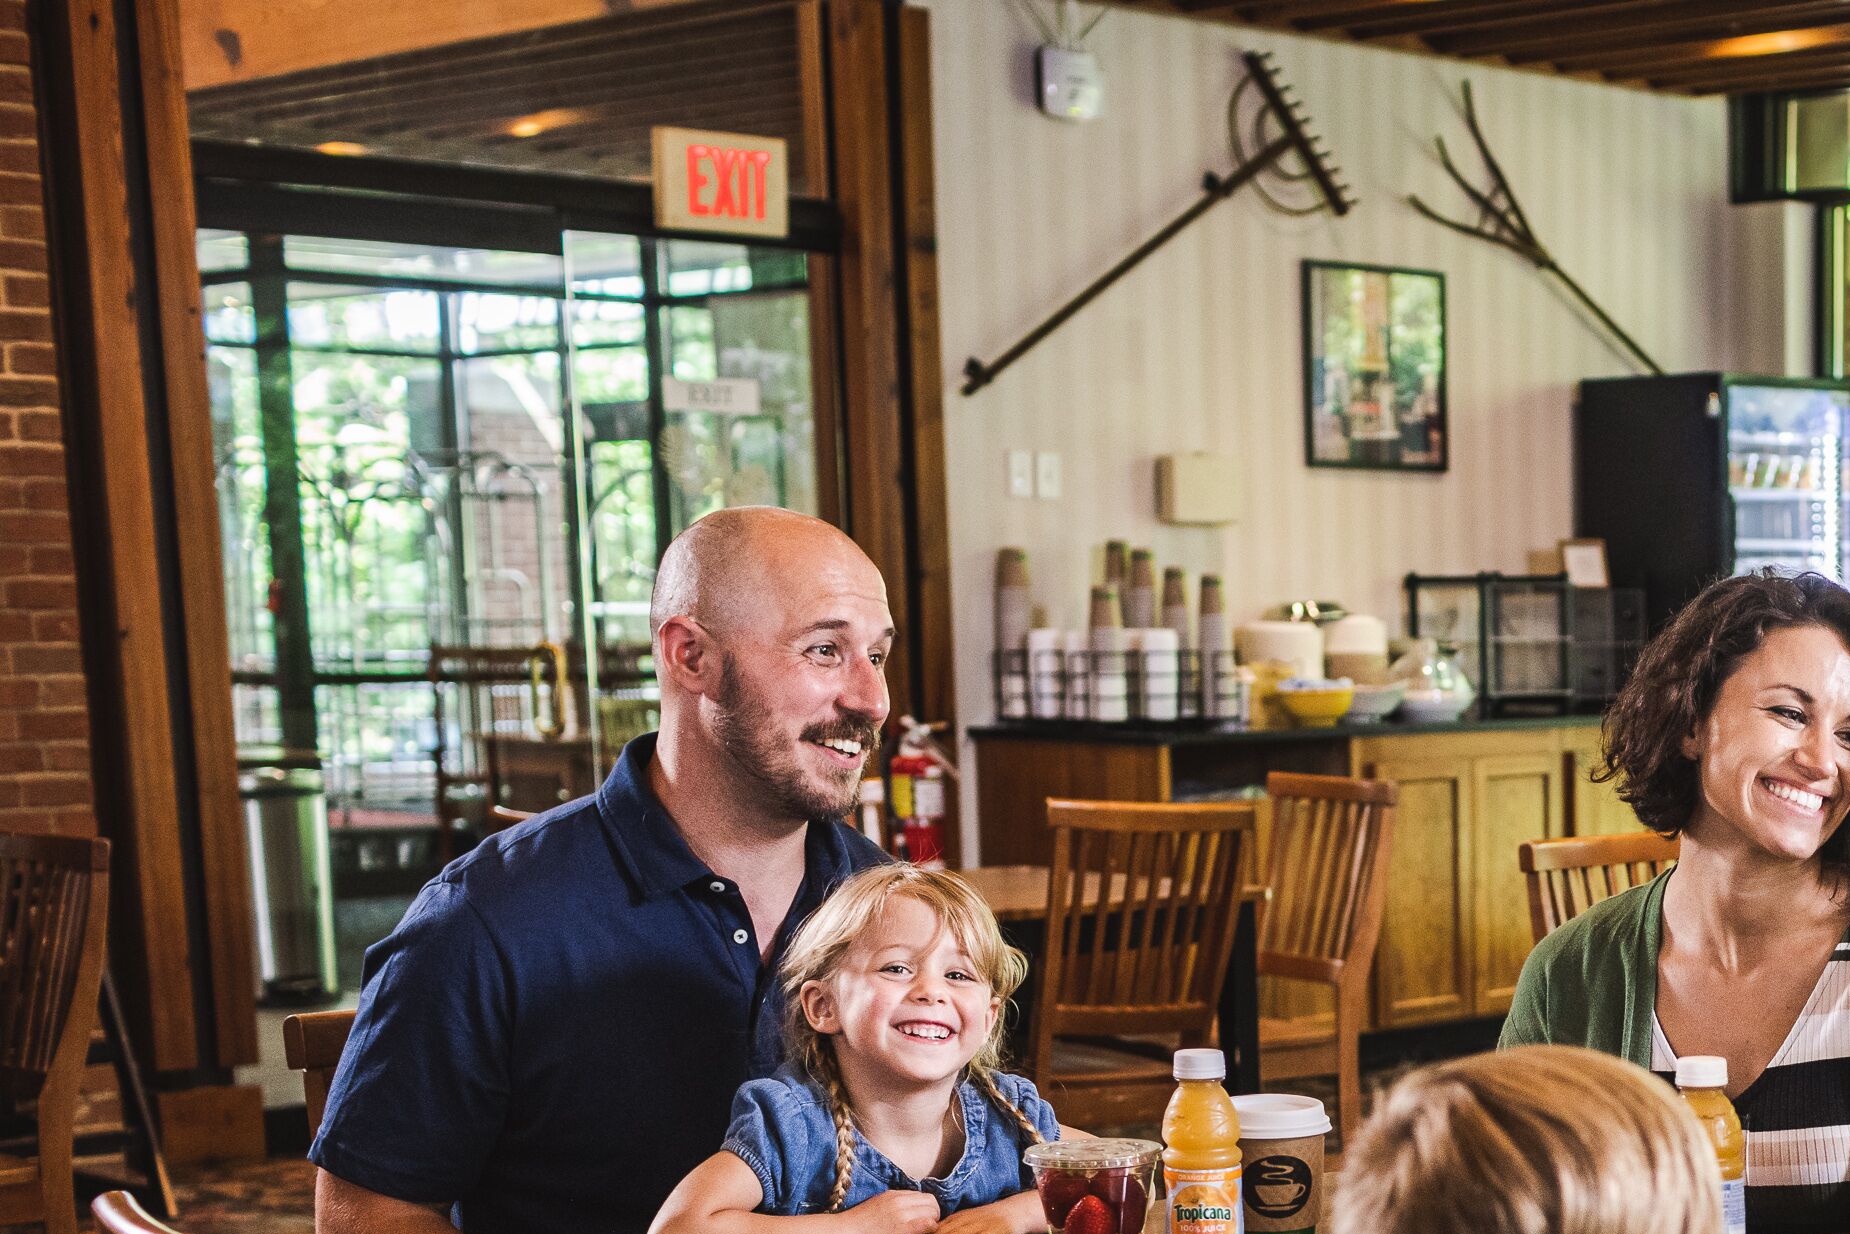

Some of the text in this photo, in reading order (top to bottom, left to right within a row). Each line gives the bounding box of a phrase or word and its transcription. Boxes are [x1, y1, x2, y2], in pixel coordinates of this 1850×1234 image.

[687, 144, 770, 220] EXIT
[1174, 1204, 1231, 1222] Tropicana
[1181, 1224, 1226, 1233] 100% JUICE
